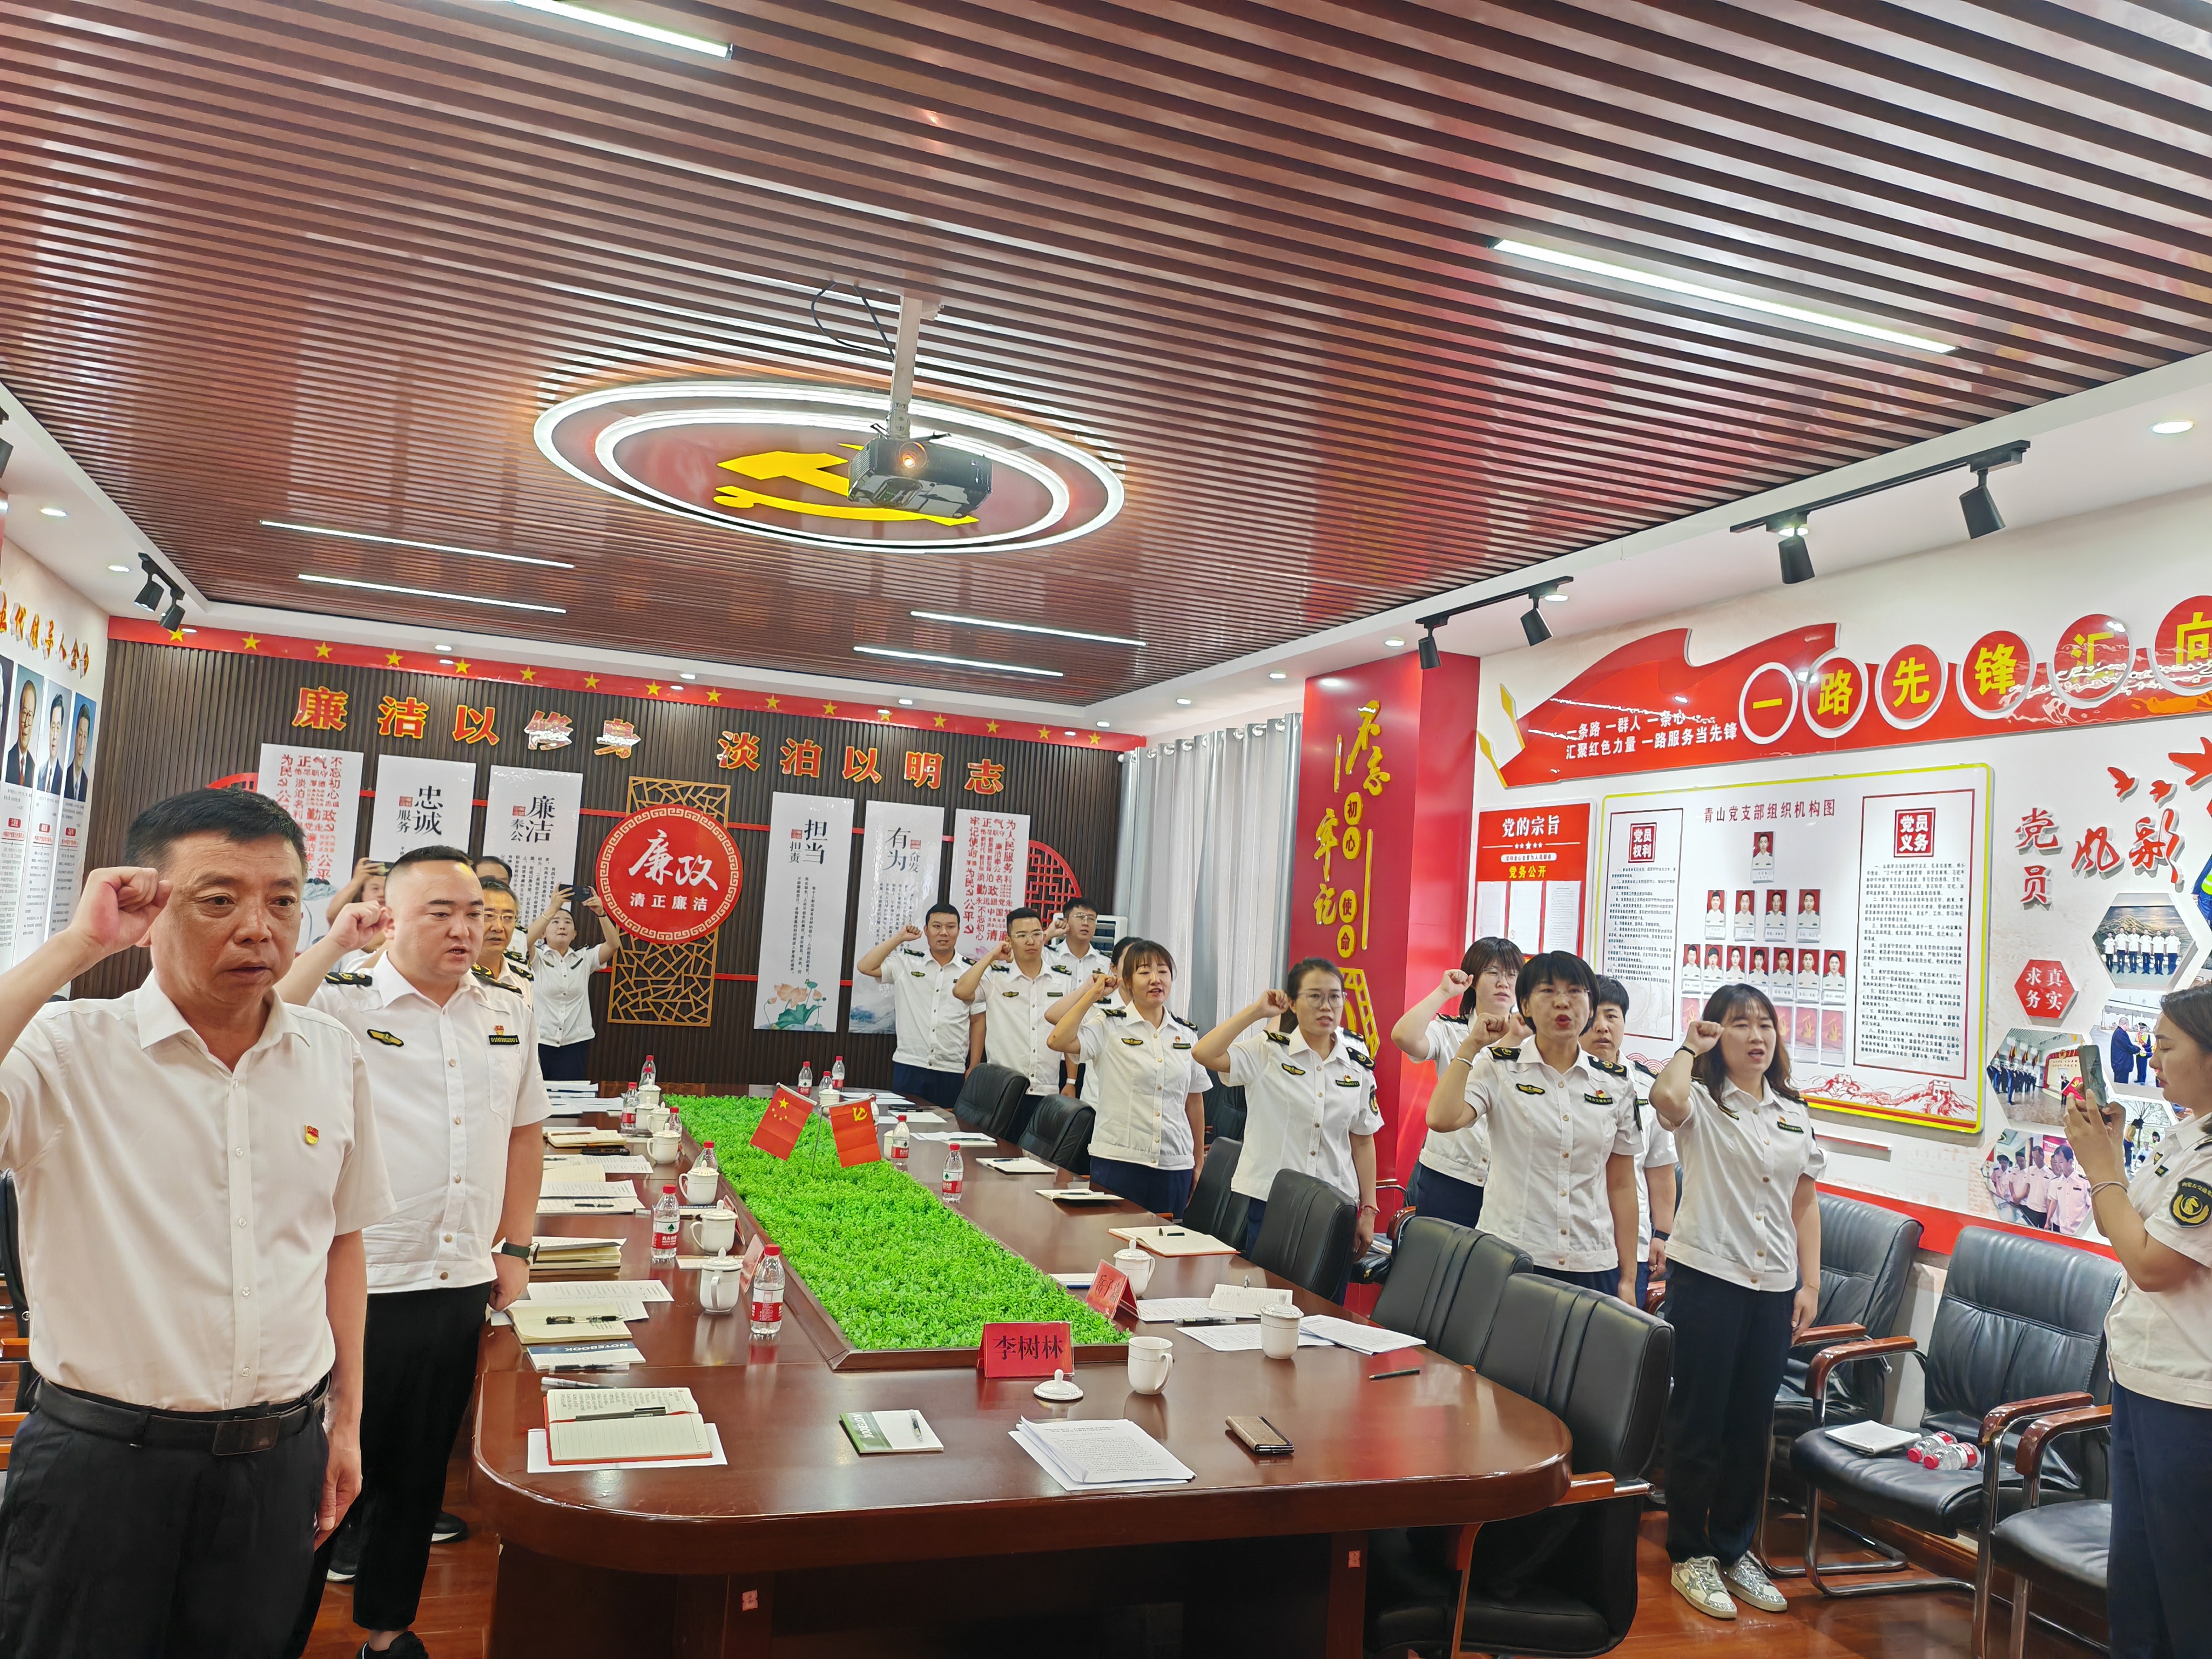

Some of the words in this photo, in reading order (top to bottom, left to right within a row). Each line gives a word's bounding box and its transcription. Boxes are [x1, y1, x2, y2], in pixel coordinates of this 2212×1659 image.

[291, 685, 641, 759] 廉洁以修身
[1567, 721, 1601, 739] 一条路
[1606, 715, 1641, 733] 一群人
[1566, 735, 1636, 760] 汇聚红色力量
[1642, 721, 1738, 749] 一路服务当先锋
[717, 730, 1006, 795] 淡泊以明志
[412, 785, 443, 835] 忠诚
[526, 795, 556, 843] 廉洁
[1703, 799, 1835, 824] 青山党支部组织机构图
[1346, 800, 1358, 852] 初心
[1502, 814, 1560, 838] 党的宗旨
[1633, 828, 1653, 843] 党员
[1900, 814, 1928, 833] 党员
[802, 819, 828, 865] 担当
[882, 827, 911, 871] 有为
[1003, 819, 1016, 874] 为人民服务
[1633, 844, 1653, 860] 权利
[1898, 833, 1928, 852] 义务
[629, 829, 718, 891] 廉政
[2015, 807, 2059, 905] 党员
[1509, 865, 1547, 879] 党务公开
[630, 892, 709, 912] 清正廉洁
[1340, 897, 1353, 951] 使命
[2026, 967, 2063, 987] 求真
[2026, 989, 2063, 1010] 务实
[565, 1343, 628, 1352] NOTEBOOK
[993, 1334, 1064, 1360] 李树林
[852, 1413, 875, 1439] NOTEBOOK
